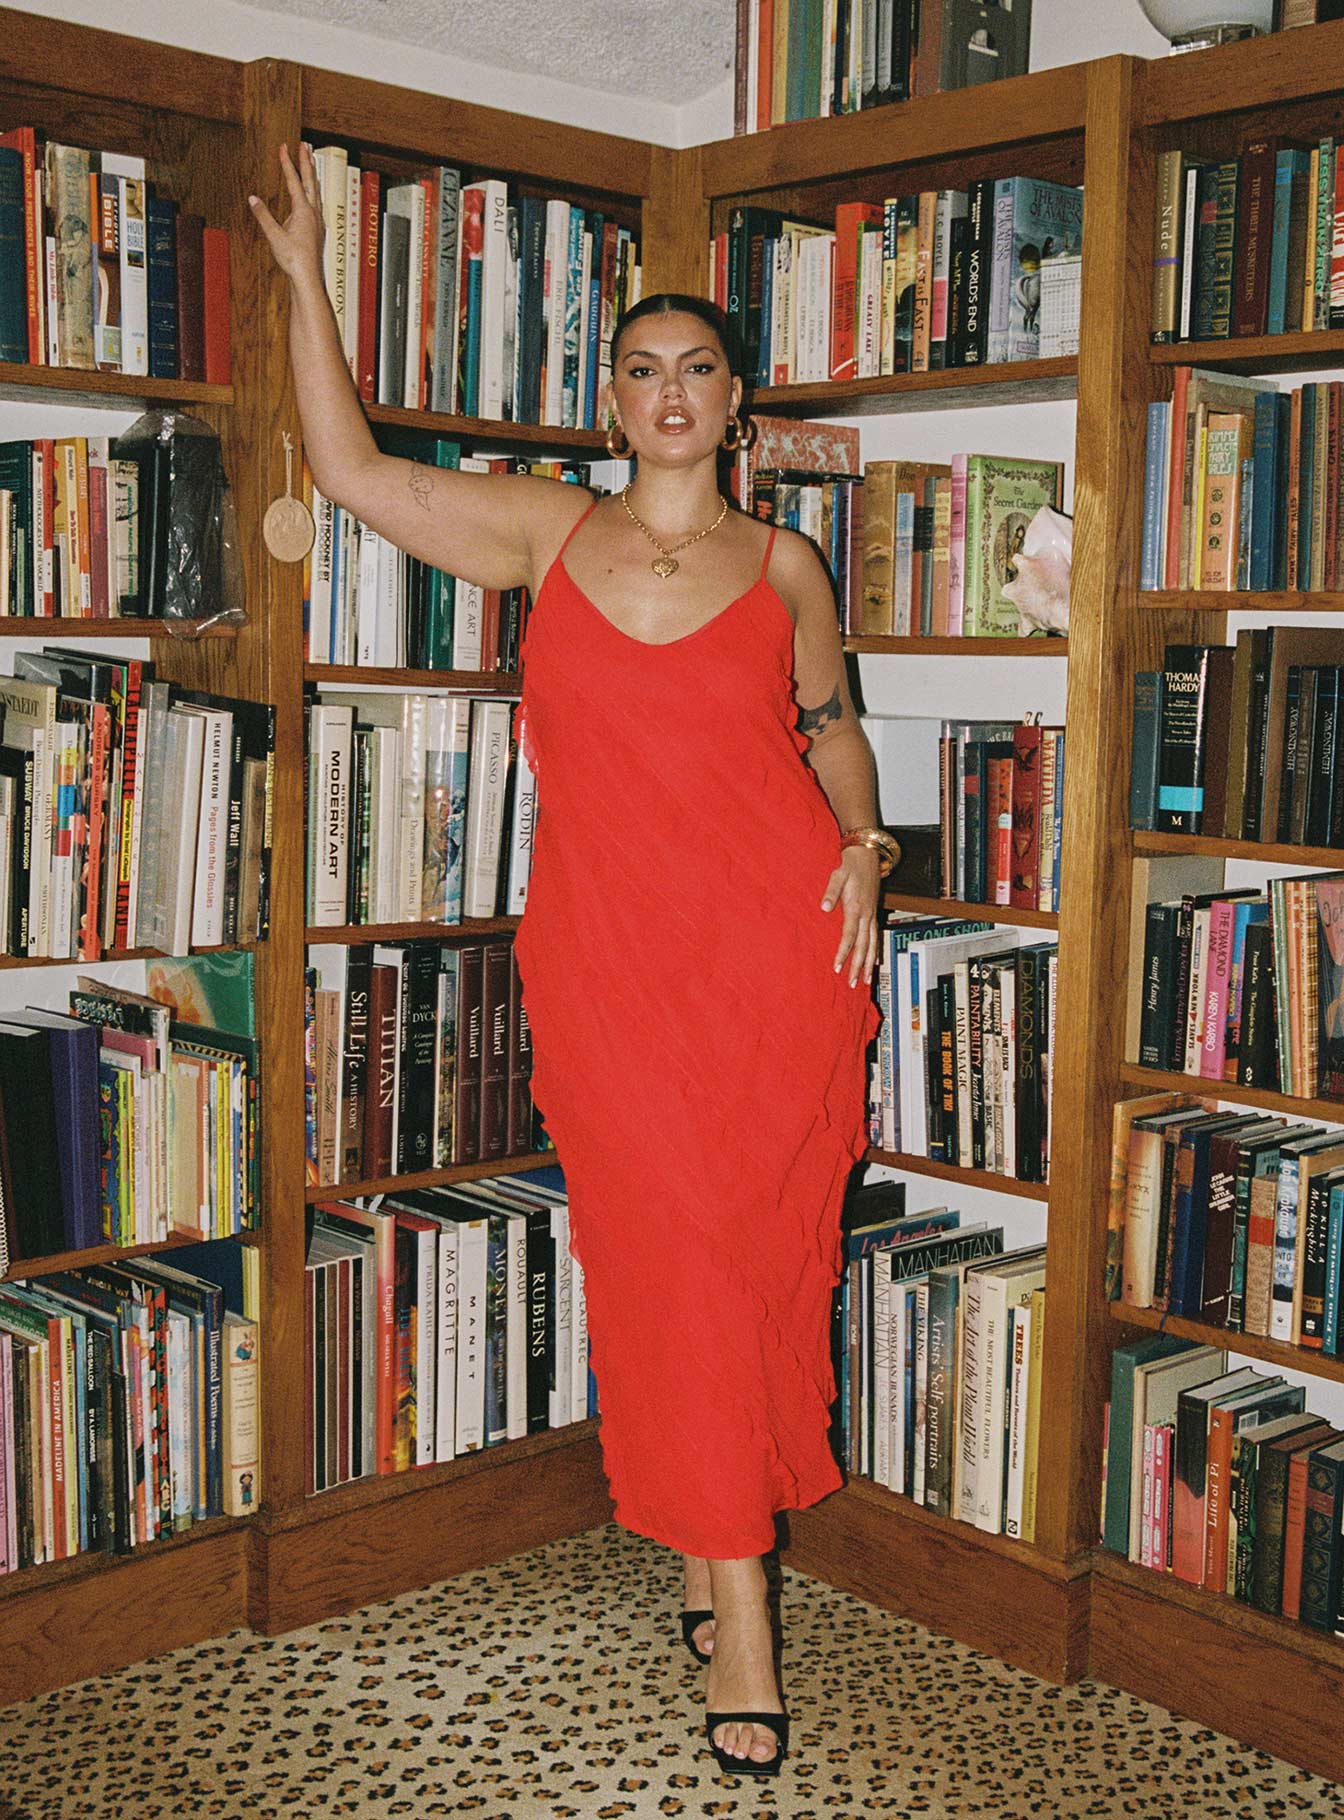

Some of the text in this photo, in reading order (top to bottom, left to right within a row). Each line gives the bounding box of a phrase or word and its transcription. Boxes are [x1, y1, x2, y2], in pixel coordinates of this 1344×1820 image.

[104, 199, 113, 248] BIBLE
[127, 221, 144, 235] HOLY
[368, 203, 377, 267] BOTERO
[494, 197, 504, 232] DALI
[1160, 205, 1172, 251] Nude
[1249, 200, 1259, 234] THREE
[1315, 144, 1329, 294] LESS THAN ZERO
[127, 235, 144, 249] BIBLE
[335, 205, 345, 315] FRANCIS BACON
[935, 235, 943, 267] BOYLE
[996, 222, 1005, 261] AVALON
[1245, 236, 1257, 302] MUSKETEERS
[590, 290, 599, 342] GAUGUIN
[968, 306, 977, 332] END
[994, 497, 1016, 508] Secret
[467, 614, 476, 636] ART
[1168, 682, 1200, 692] HARDY
[213, 723, 221, 758] HELMUT
[488, 732, 500, 784] PICASSO
[1287, 707, 1298, 770] HEMINGWAY
[1321, 710, 1333, 775] HEMINGWAY
[24, 761, 33, 802] SUBWAY
[93, 722, 103, 816] ANDREAS GURSKY
[211, 762, 220, 799] NEWTON
[1042, 739, 1054, 807] MATILDA
[117, 690, 139, 926] LACHAPELLE LAND
[330, 750, 340, 837] MODERN
[44, 793, 52, 841] GERMANY
[207, 806, 218, 832] Pages
[230, 800, 240, 846] Jeff Wall
[519, 792, 533, 850] RODIN
[208, 835, 217, 854] from
[328, 842, 338, 879] ART
[408, 820, 417, 859] Drawings
[206, 873, 215, 908] Glossies
[20, 908, 28, 947] APERTURE
[895, 922, 991, 949] THE ONE SHOW
[1216, 911, 1230, 977] THE DIAMOND
[881, 992, 890, 1018] THE
[1148, 956, 1159, 1011] Henry James
[1191, 973, 1199, 994] YORK
[350, 992, 367, 1027] Still
[412, 1011, 436, 1024] DYCK
[493, 1003, 505, 1055] Vuillard
[970, 984, 981, 1068] PAINTABILITY
[1021, 960, 1033, 1079] DIAMONDS
[1206, 992, 1219, 1051] KAREN KARBO
[343, 1034, 365, 1068] Life
[469, 1006, 480, 1058] Vuillard
[882, 1021, 890, 1048] ONE
[941, 1031, 951, 1048] THE
[957, 1007, 967, 1092] PAINT MAGIC
[379, 1009, 396, 1108] TITIAN
[942, 1051, 952, 1075] BOOK
[348, 1084, 358, 1130] HISTORY
[944, 1094, 953, 1111] TIKI
[1306, 1188, 1319, 1263] Mockingbird
[516, 1239, 526, 1305] ROUAULT
[899, 1233, 998, 1279] MANHATTAN
[383, 1286, 394, 1324] Chagall
[444, 1249, 455, 1356] MAGRITTE
[494, 1249, 506, 1322] MONET
[559, 1257, 570, 1332] SARGENT
[967, 1295, 981, 1319] The
[425, 1301, 433, 1339] KAHLO
[531, 1271, 546, 1357] RUBENS
[875, 1257, 889, 1369] MANHATTAN
[917, 1290, 926, 1361] THE VIKING
[468, 1296, 476, 1380] MANET
[890, 1313, 898, 1376] NORWEGIAN
[966, 1325, 978, 1346] Art
[986, 1339, 994, 1365] MOST
[1015, 1324, 1024, 1365] TREES
[210, 1330, 219, 1418] Illustrated Poems
[984, 1366, 993, 1415] BEAUTIFUL
[53, 1380, 61, 1420] AMERICA
[964, 1385, 976, 1421] Plant
[55, 1437, 63, 1481] MADELINE
[963, 1423, 976, 1467] World
[983, 1418, 991, 1460] FLOWERS
[1208, 1498, 1218, 1527] Life
